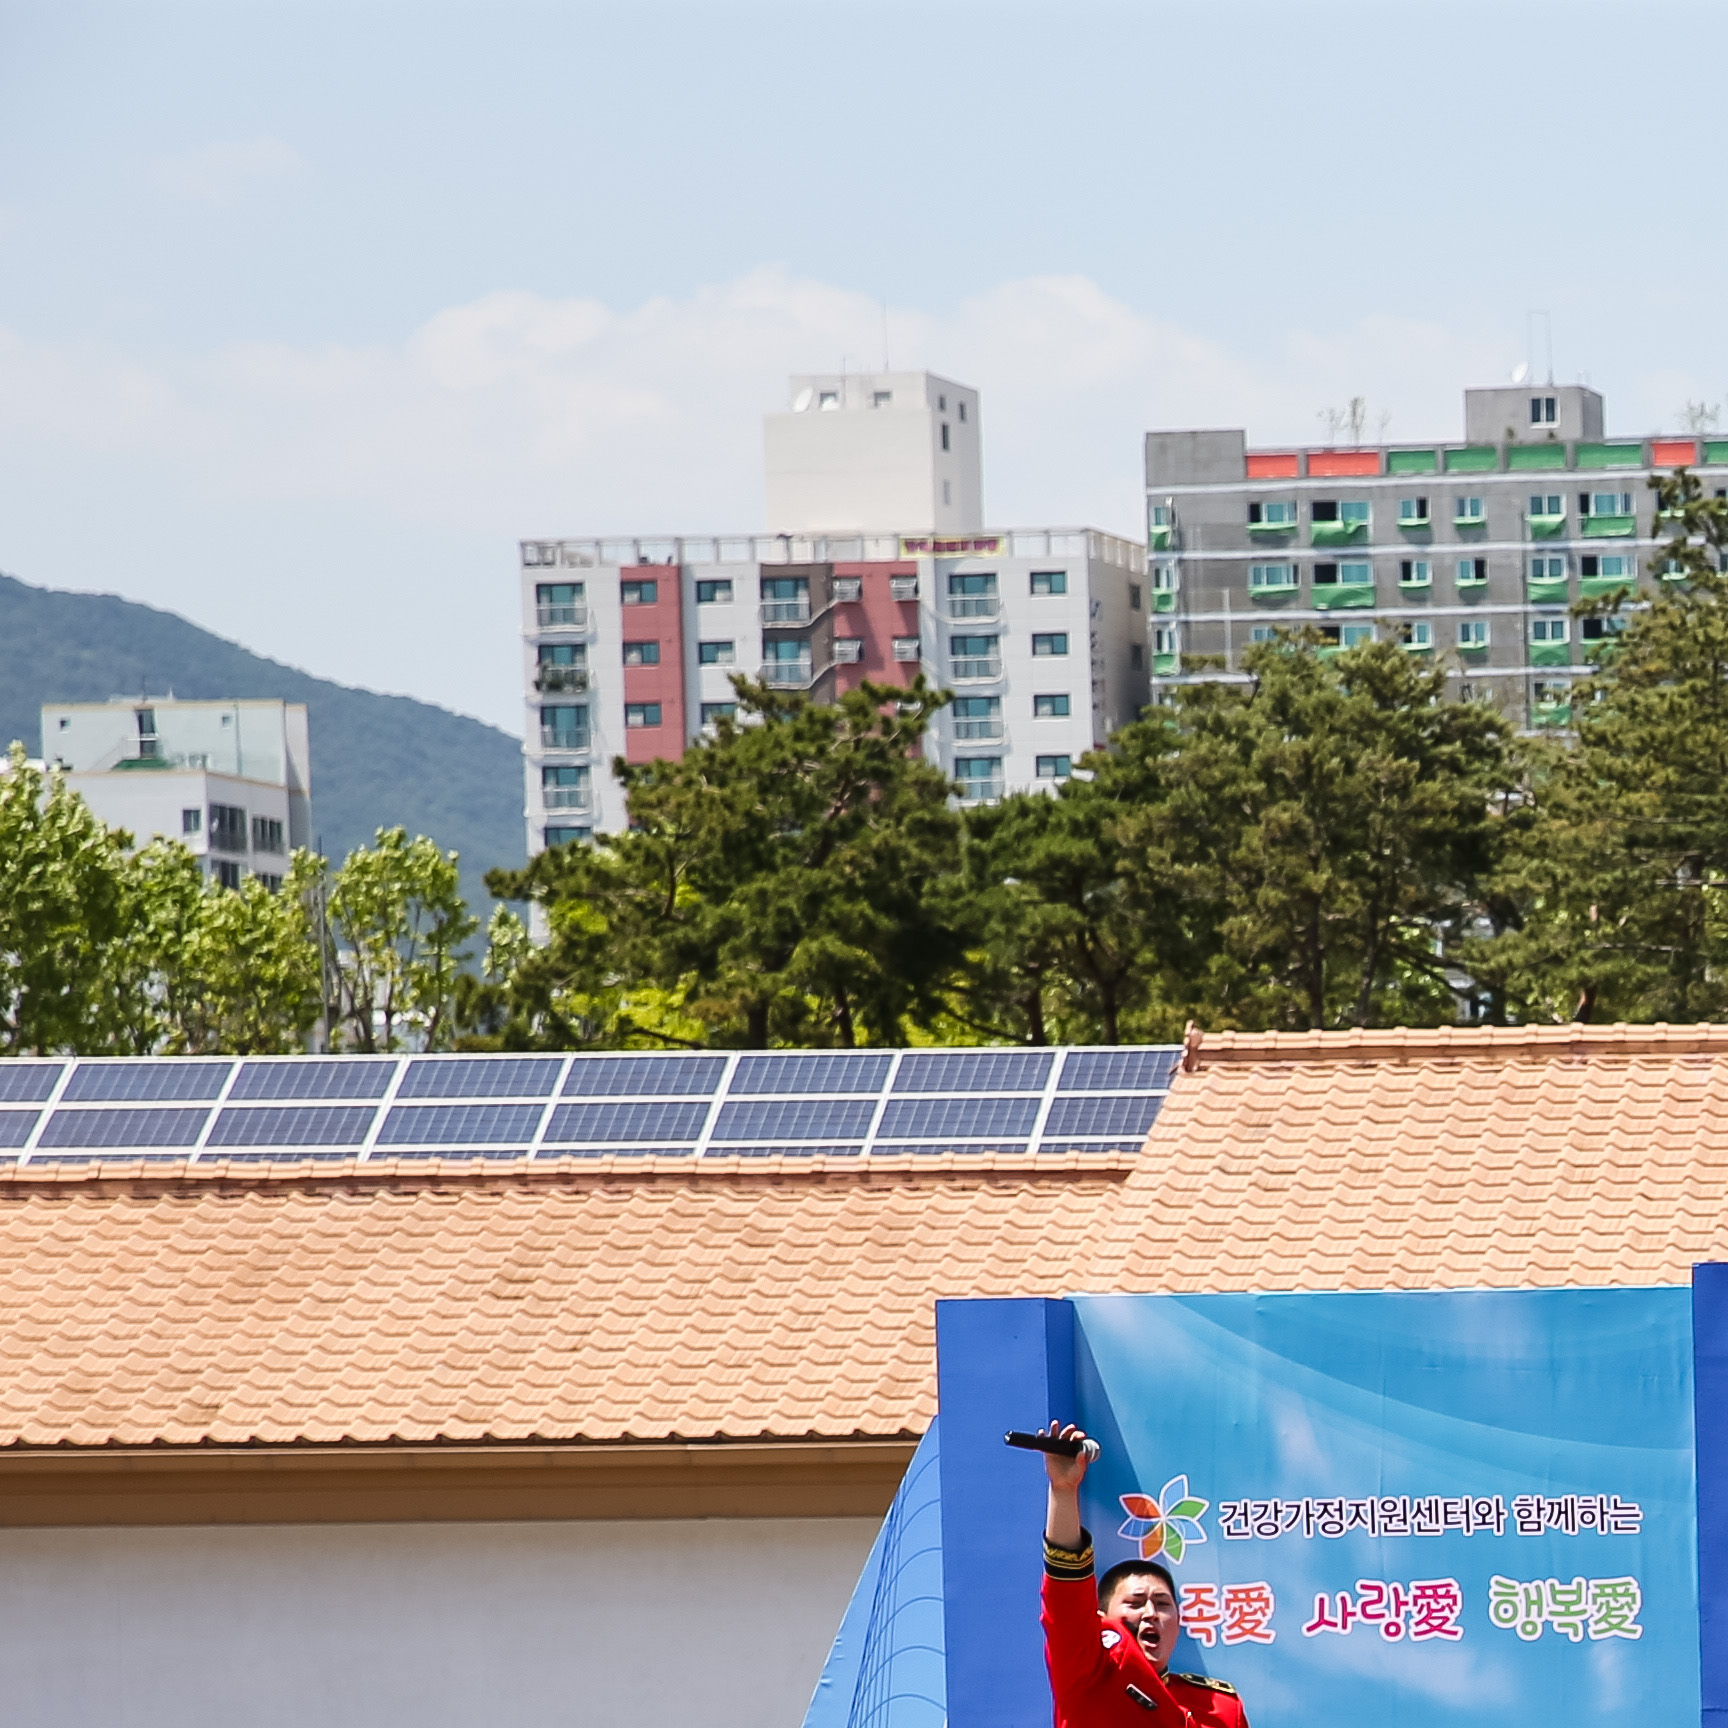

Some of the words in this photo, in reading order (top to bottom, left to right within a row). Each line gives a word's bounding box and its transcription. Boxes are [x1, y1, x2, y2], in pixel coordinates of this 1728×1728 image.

[1219, 1497, 1505, 1538] 건강가정지원센터와
[1513, 1496, 1642, 1535] 함께하는
[1179, 1582, 1272, 1643] 족愛
[1305, 1581, 1462, 1638] 사랑愛
[1490, 1578, 1642, 1638] 행복愛
